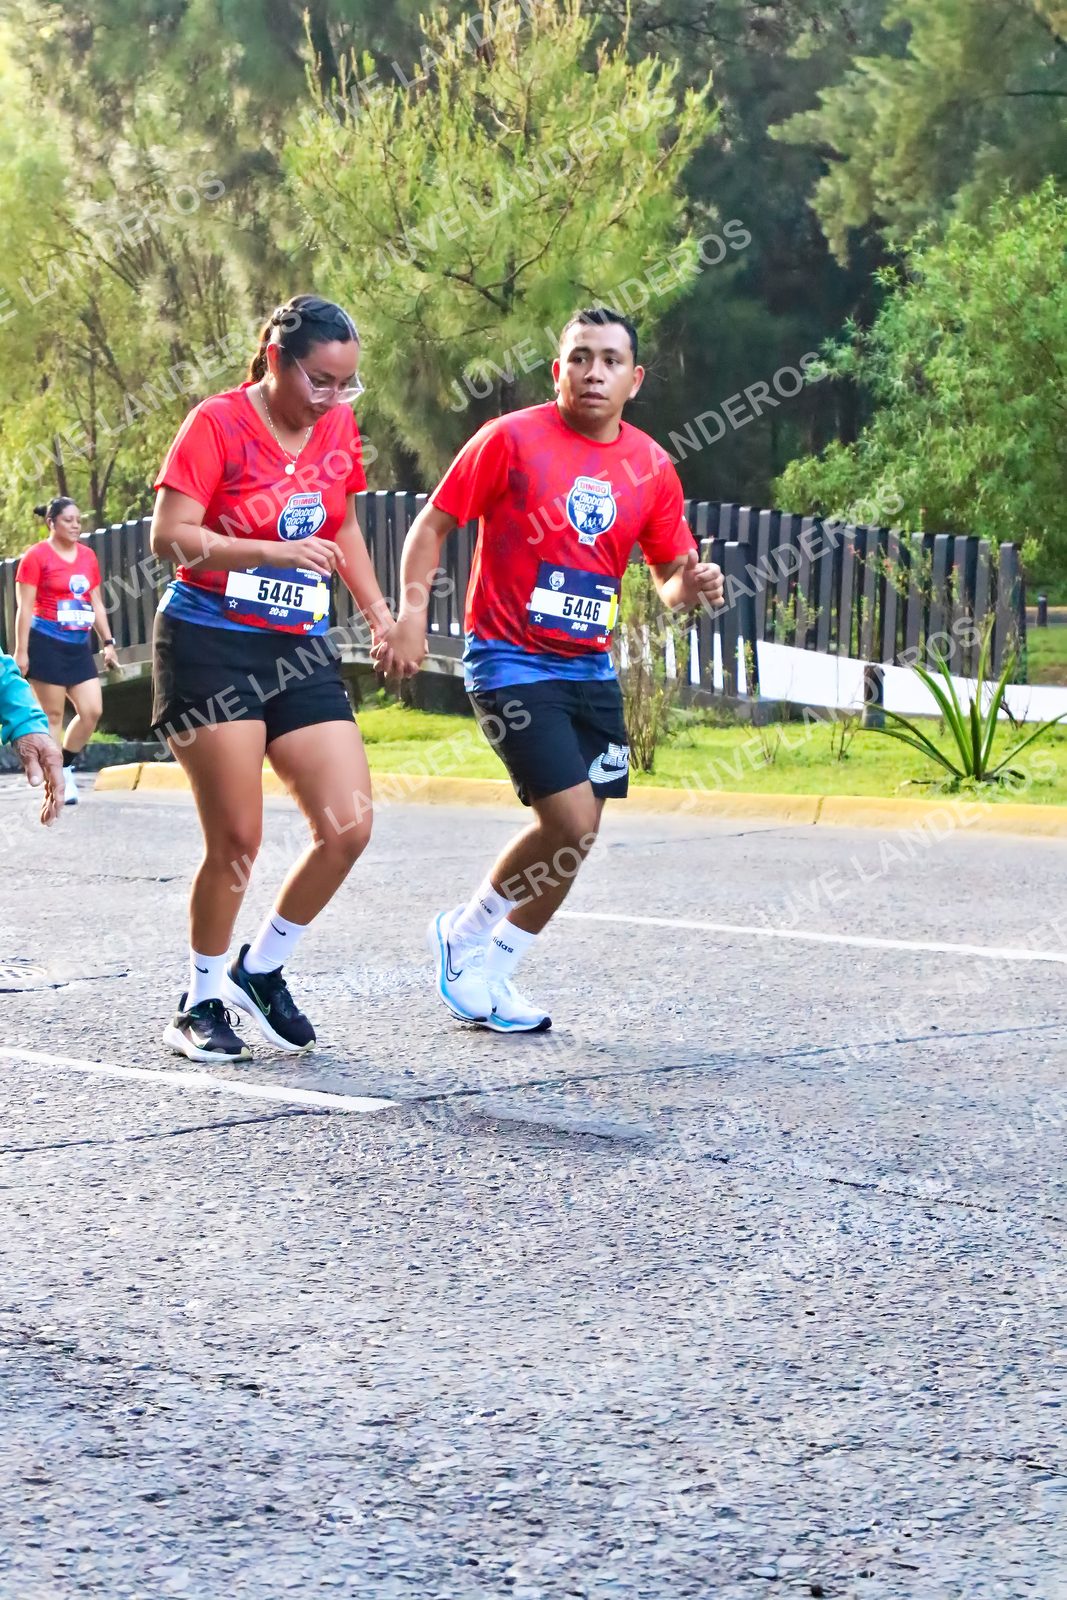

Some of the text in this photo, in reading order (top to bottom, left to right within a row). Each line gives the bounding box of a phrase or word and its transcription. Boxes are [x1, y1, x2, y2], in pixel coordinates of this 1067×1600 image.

[292, 497, 318, 506] BIMBO
[579, 493, 605, 507] Global
[291, 507, 316, 518] Global
[574, 501, 594, 513] Race
[257, 579, 304, 608] 5445
[562, 596, 601, 622] 5446
